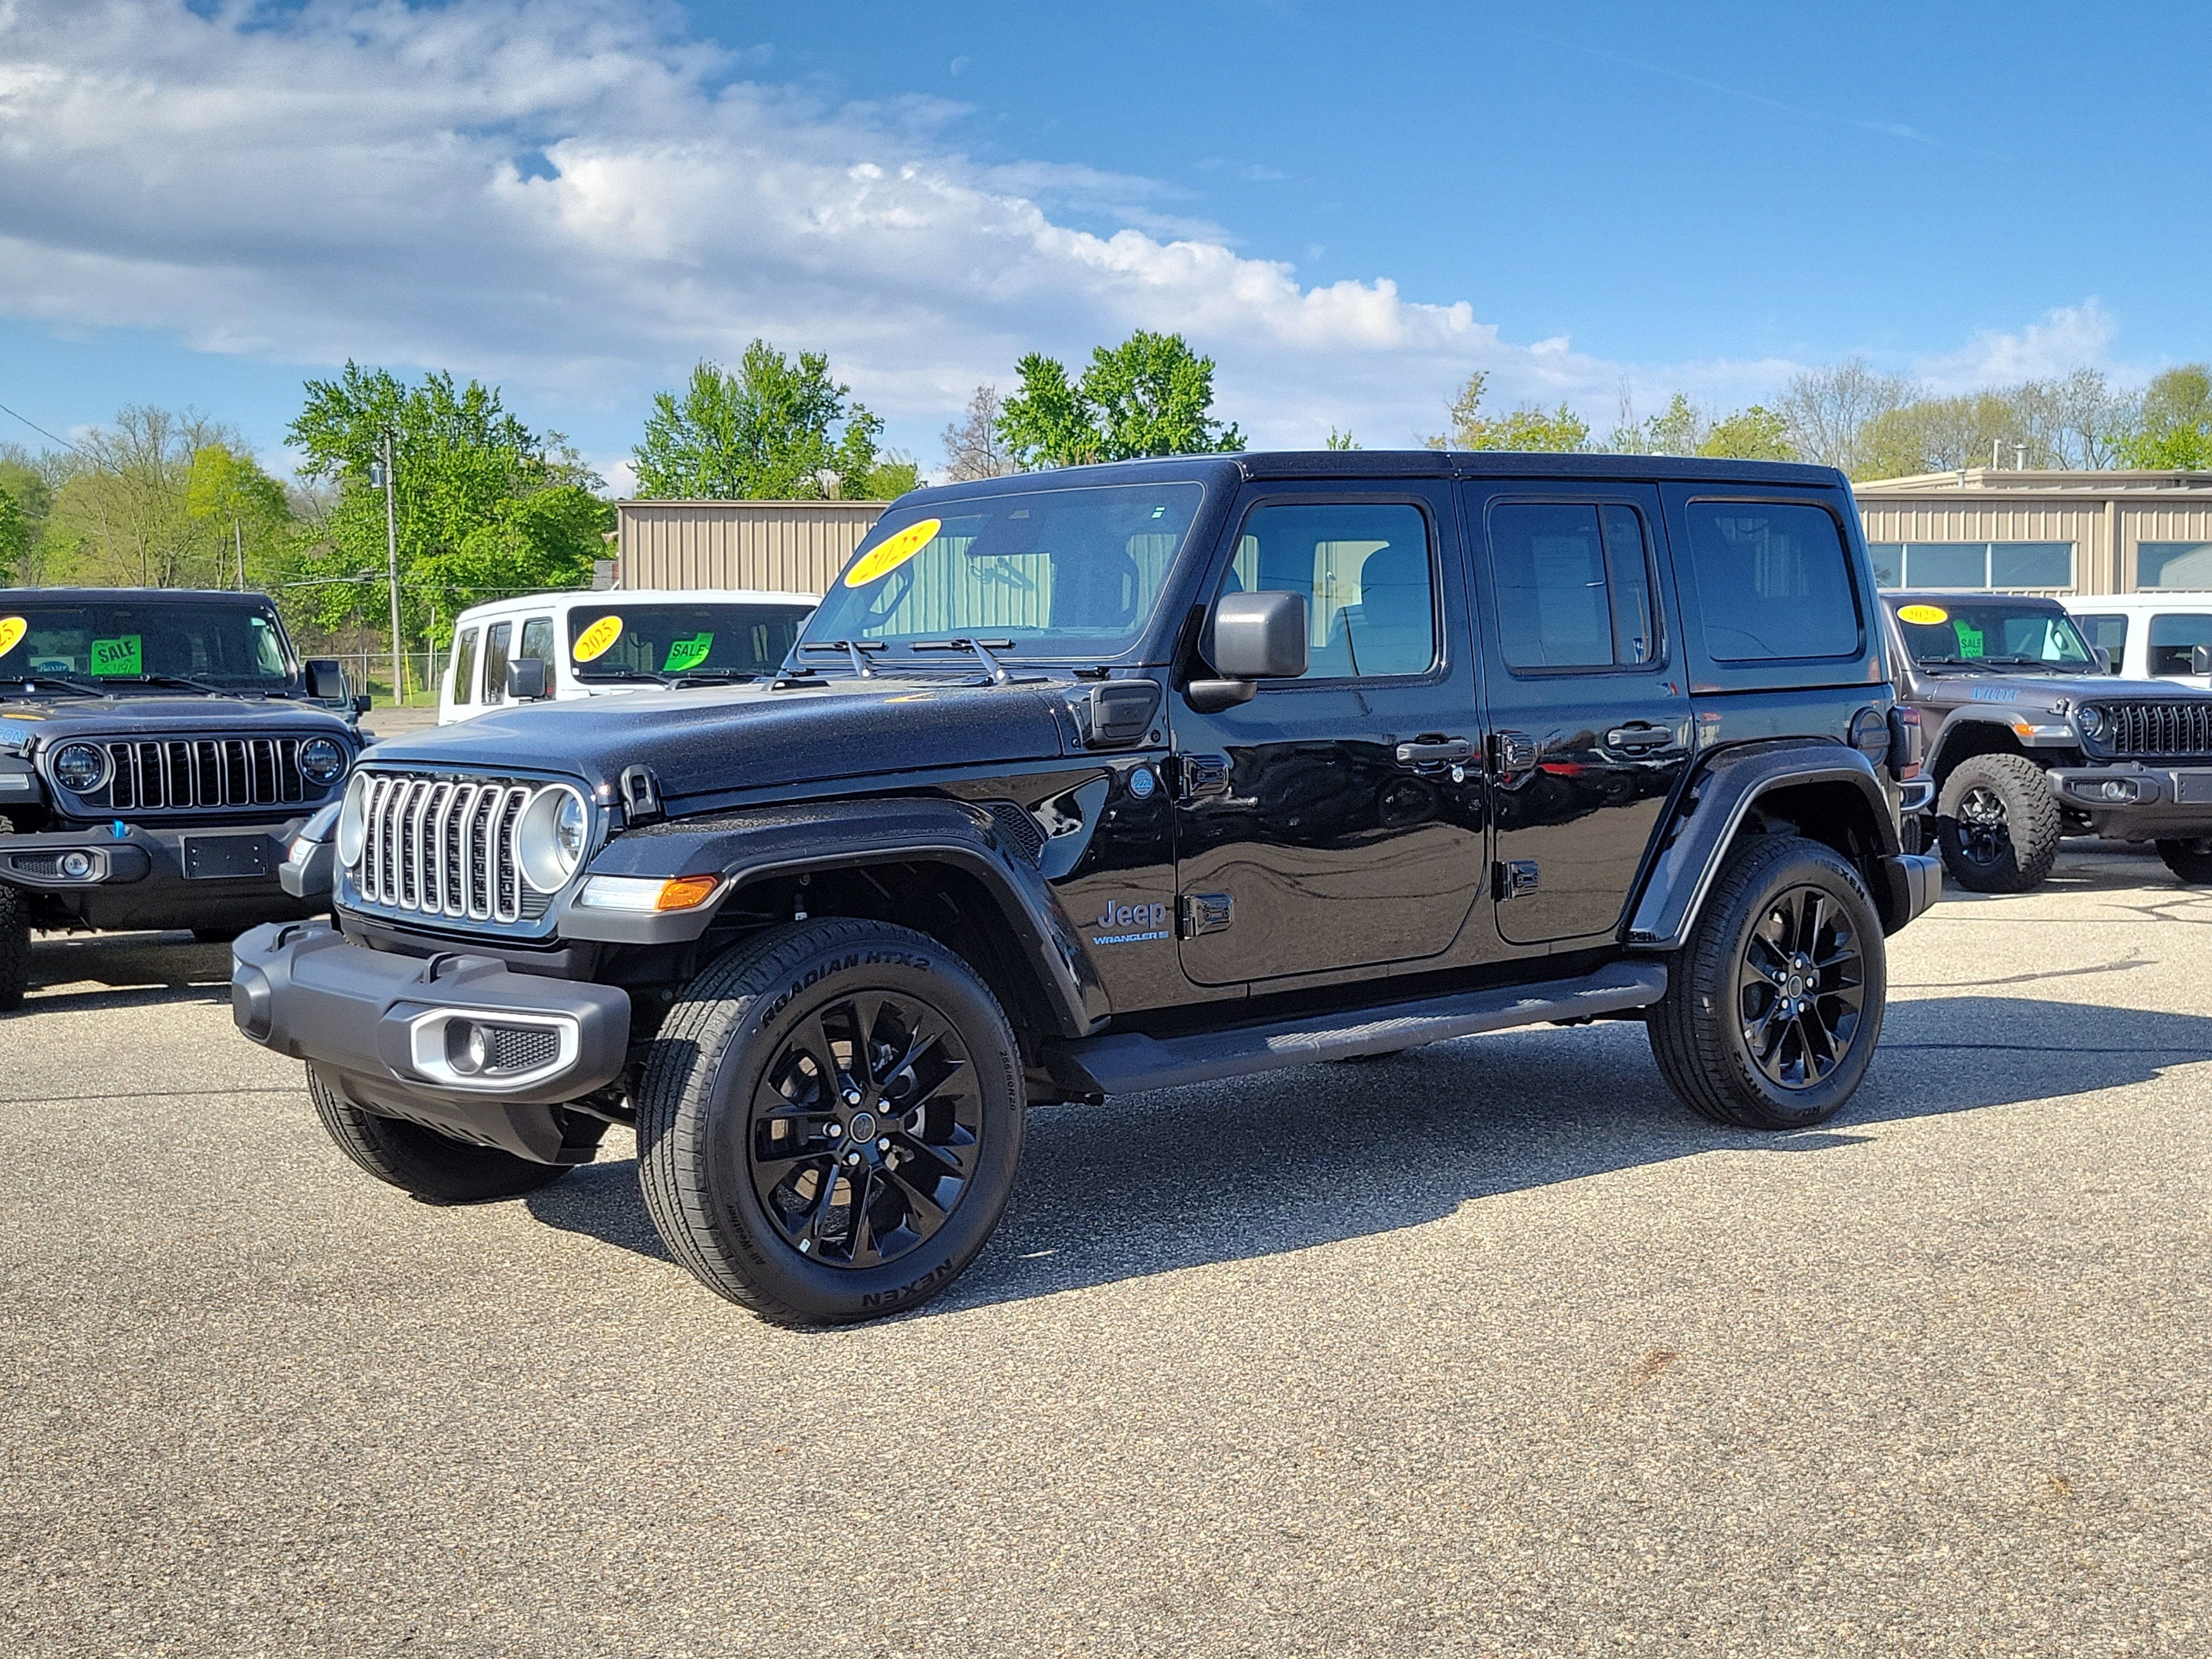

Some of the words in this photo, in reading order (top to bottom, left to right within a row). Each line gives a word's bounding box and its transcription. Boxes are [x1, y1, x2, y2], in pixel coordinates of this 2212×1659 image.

[98, 640, 136, 663] SALE
[582, 622, 613, 657] 2025
[672, 644, 707, 657] SALE
[1961, 638, 1982, 649] SALE
[1097, 900, 1166, 930] Jeep
[1093, 932, 1158, 945] WRANGLER
[760, 953, 860, 1028] ROADIAN
[865, 950, 930, 972] HTX2
[862, 1257, 953, 1307] NEXEN
